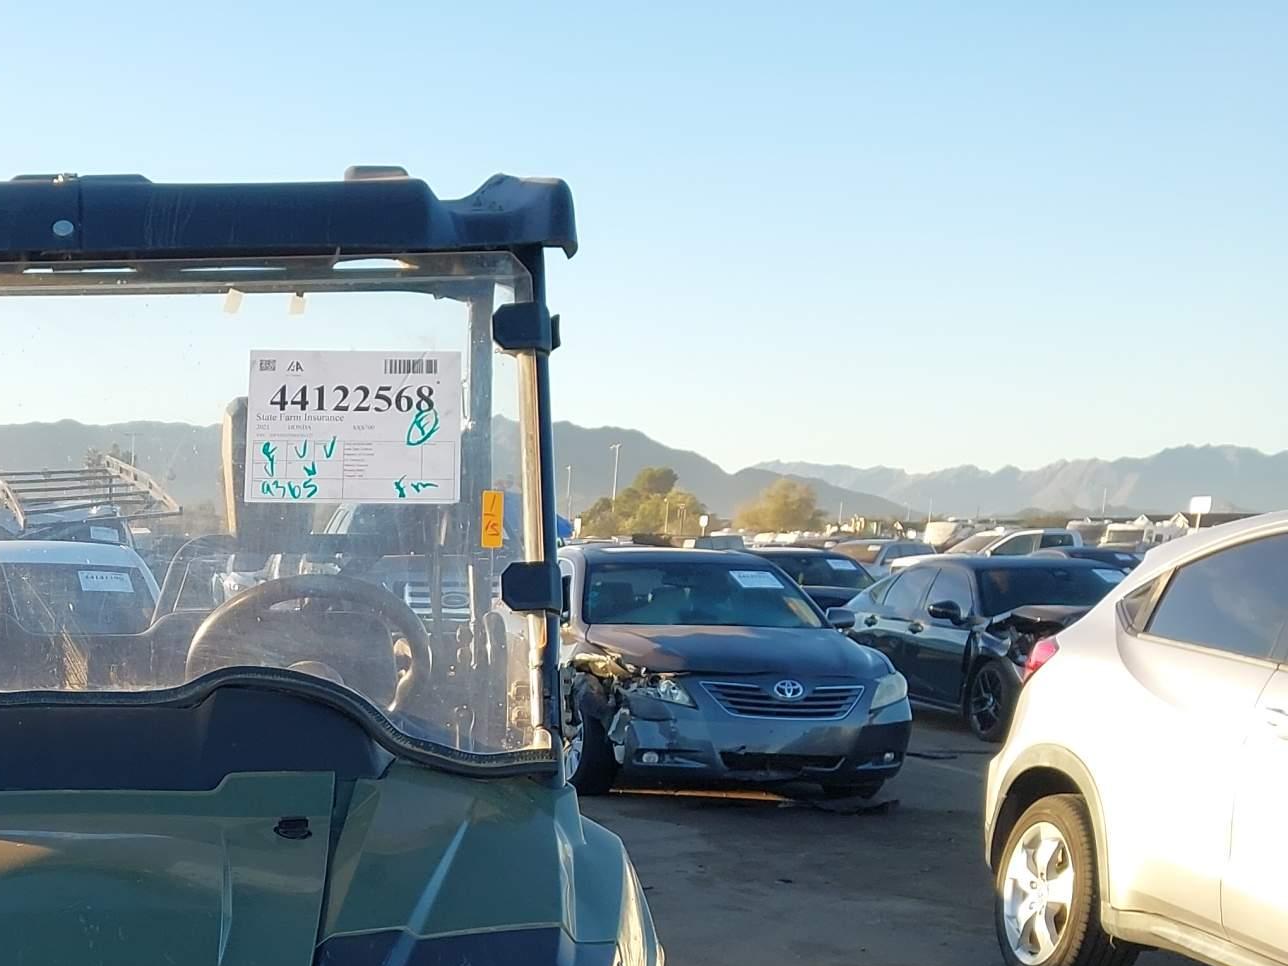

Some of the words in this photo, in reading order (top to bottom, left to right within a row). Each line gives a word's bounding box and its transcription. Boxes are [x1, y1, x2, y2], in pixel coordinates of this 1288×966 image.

[270, 384, 434, 412] 44122568
[256, 413, 277, 422] State
[280, 413, 302, 422] Farm
[304, 413, 345, 422] Insurance
